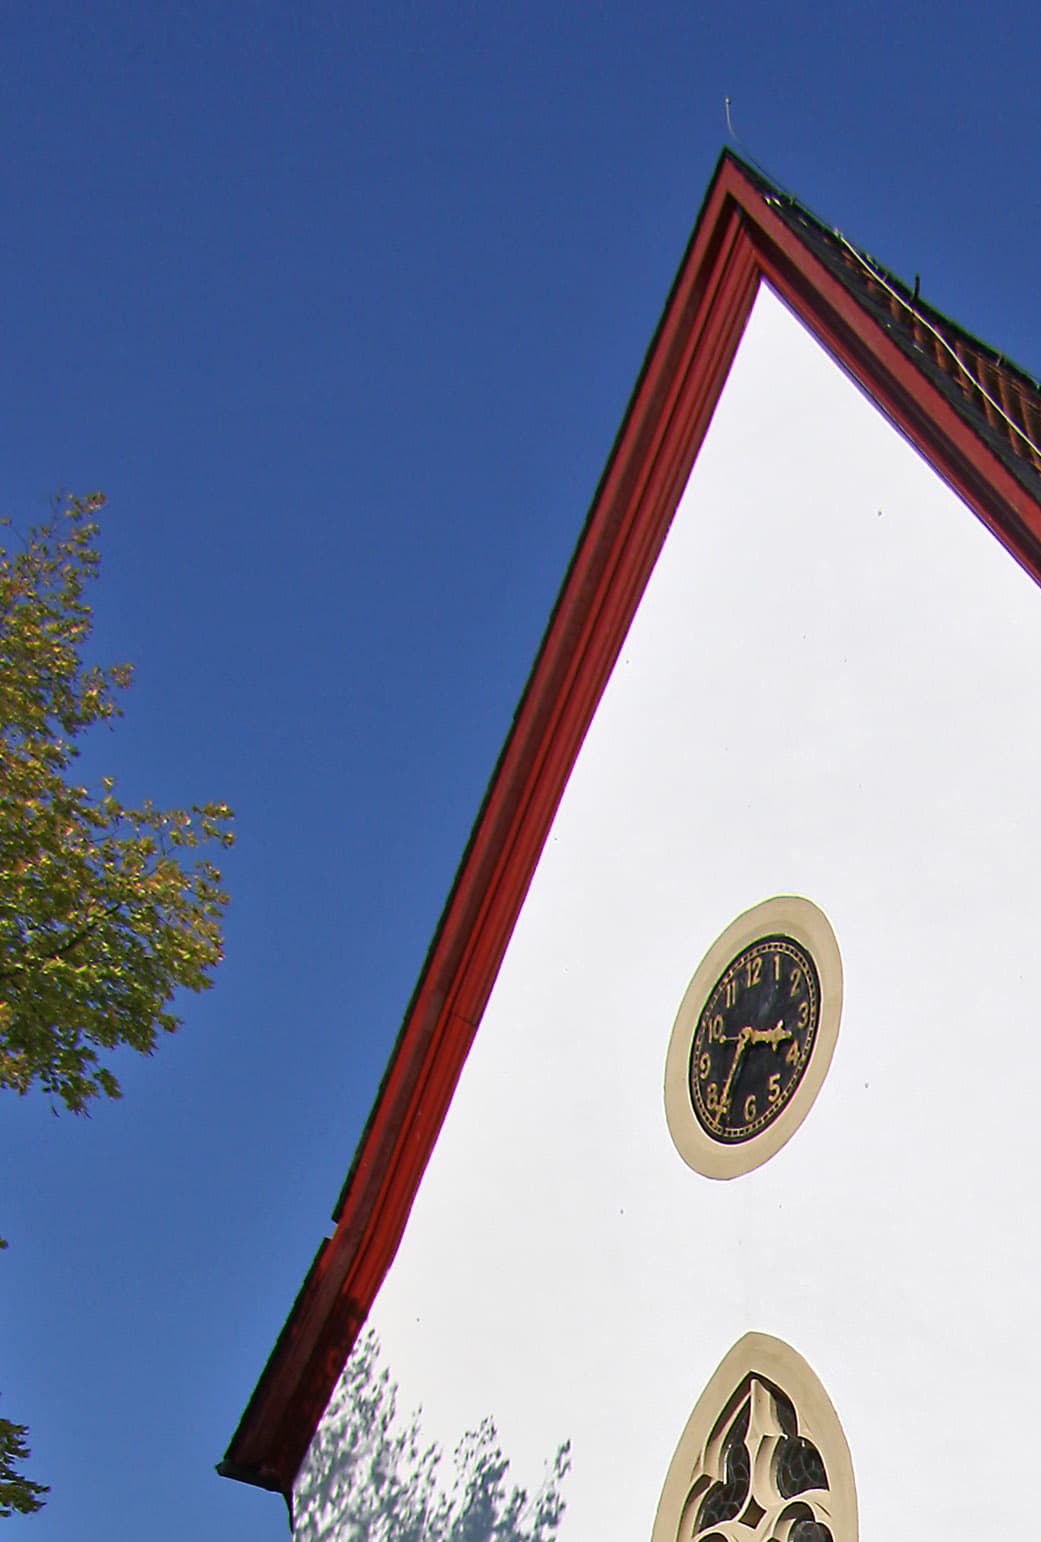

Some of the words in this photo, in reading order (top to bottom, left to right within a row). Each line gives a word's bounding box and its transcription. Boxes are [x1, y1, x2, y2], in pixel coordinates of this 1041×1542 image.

[746, 957, 762, 988] 12
[773, 954, 780, 981] 1
[725, 980, 736, 1008] 11
[790, 968, 801, 997] 2
[798, 1001, 809, 1028] 3
[708, 1014, 724, 1044] 10
[699, 1052, 711, 1079] 9
[768, 1073, 781, 1102] 5
[744, 1094, 757, 1121] 6
